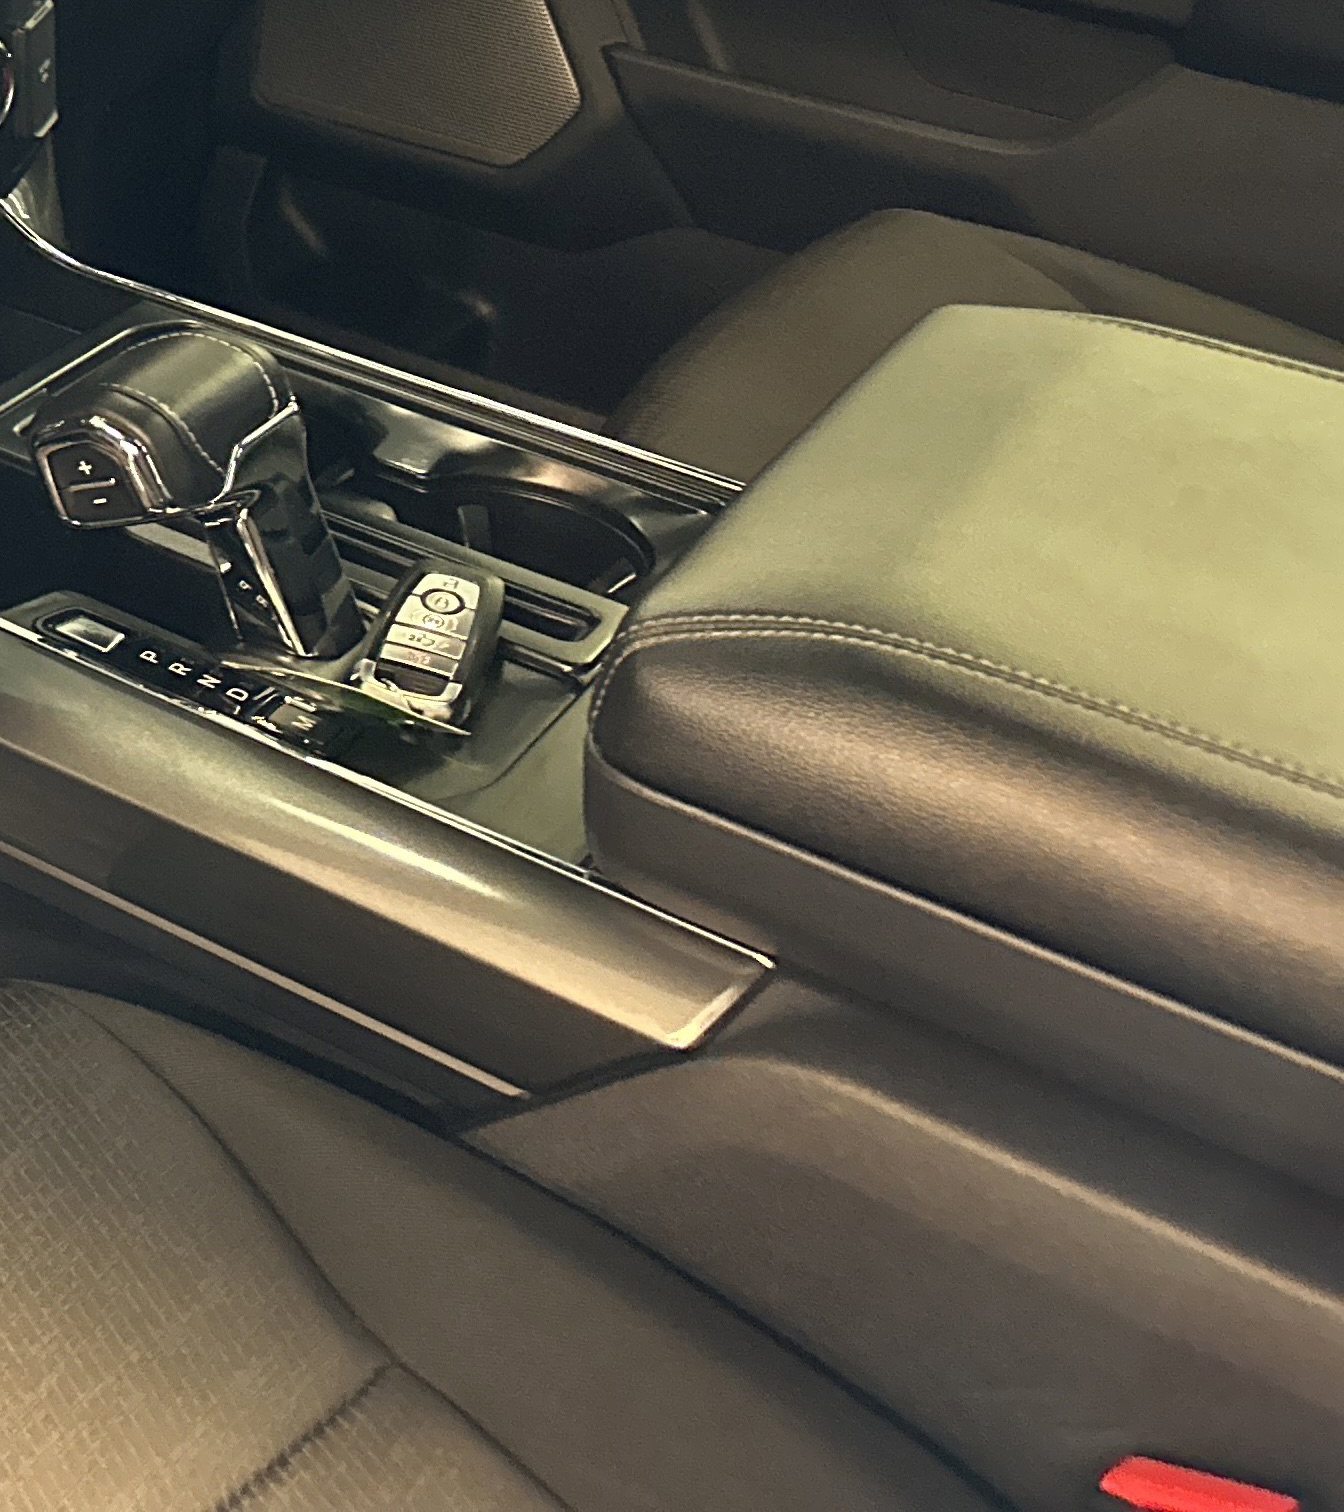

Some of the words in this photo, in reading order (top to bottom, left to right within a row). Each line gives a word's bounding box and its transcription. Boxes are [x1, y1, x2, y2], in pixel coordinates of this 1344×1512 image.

[139, 649, 159, 664] P
[167, 661, 193, 676] R
[196, 673, 222, 689] N
[225, 687, 249, 702] D
[290, 714, 317, 731] M
